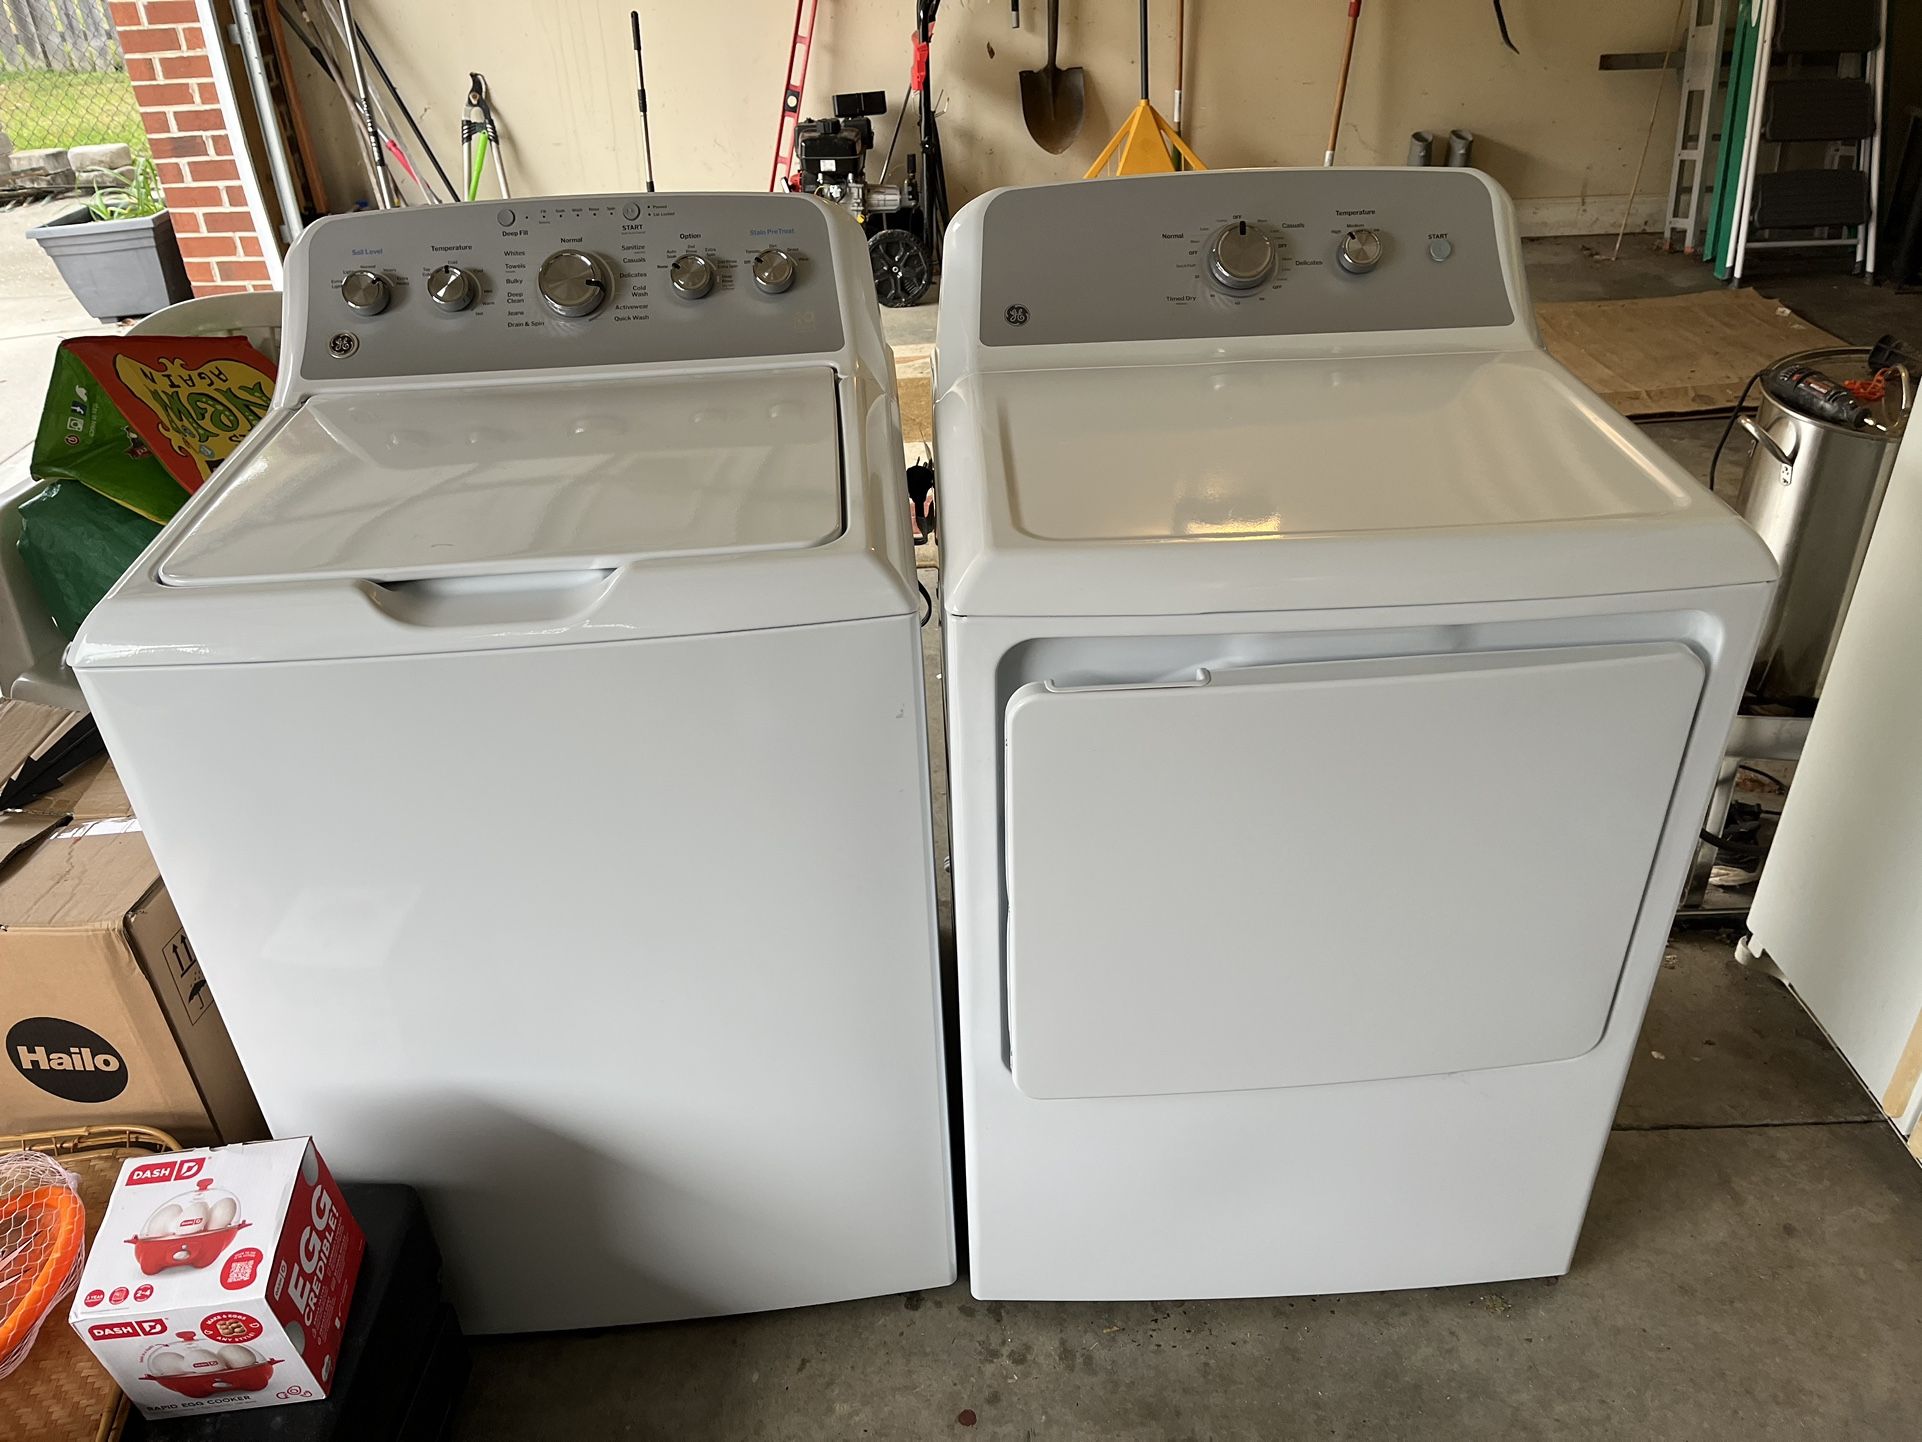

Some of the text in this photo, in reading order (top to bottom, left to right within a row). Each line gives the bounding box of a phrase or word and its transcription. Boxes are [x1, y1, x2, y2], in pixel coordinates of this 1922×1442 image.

[1335, 209, 1376, 217] Temperature
[502, 230, 518, 238] Deep
[431, 244, 472, 252] Temperature
[531, 320, 545, 328] Spin
[140, 366, 229, 389] AGAIN
[16, 1045, 120, 1072] Hailo
[132, 1167, 171, 1180] DASH
[287, 1184, 333, 1315] EGG
[304, 1204, 340, 1327] CREDIBLE!
[92, 1326, 133, 1337] DASH
[146, 1403, 178, 1412] RAPID
[206, 1395, 252, 1405] COOKER
